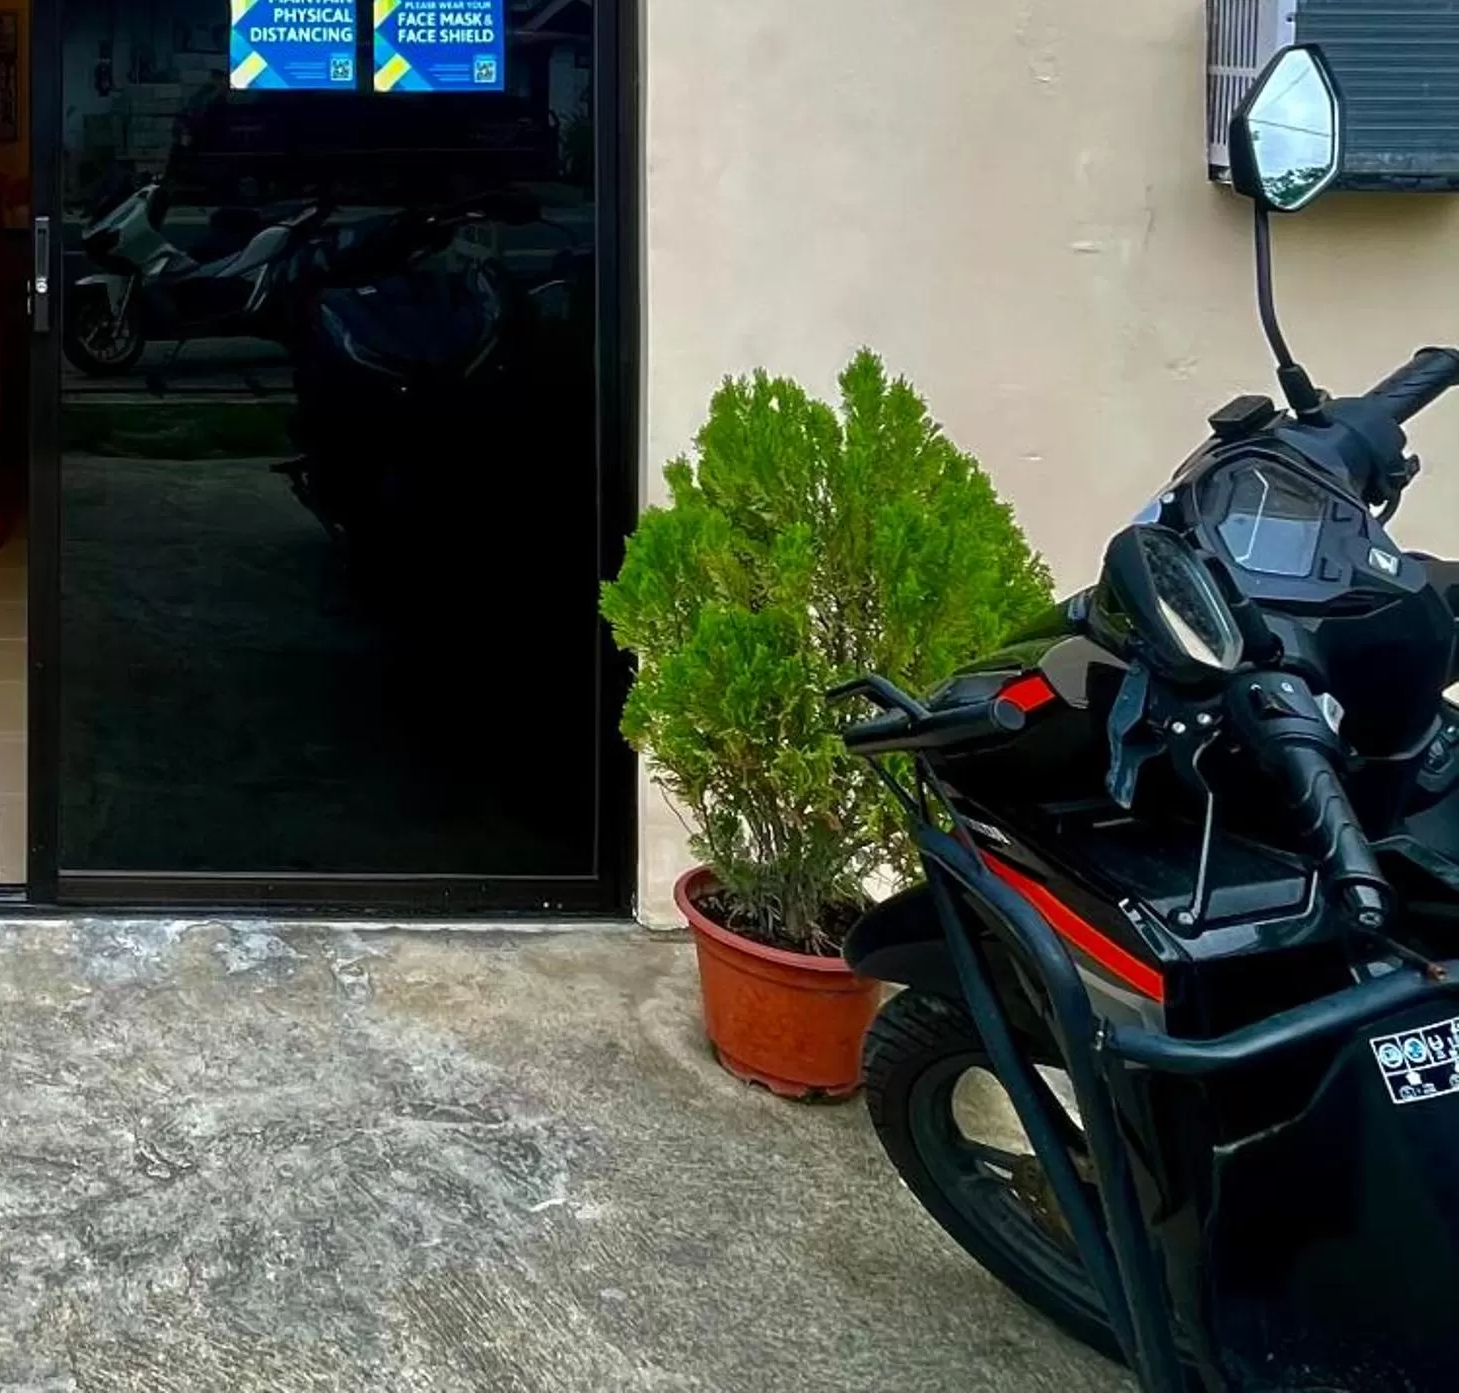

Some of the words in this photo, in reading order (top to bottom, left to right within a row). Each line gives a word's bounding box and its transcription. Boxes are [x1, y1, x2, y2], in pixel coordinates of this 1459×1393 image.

[274, 7, 354, 24] PHYSICAL
[397, 11, 437, 26] FACE
[439, 11, 482, 26] MASK
[250, 26, 354, 43] DISTANCING
[397, 28, 437, 43] FACE
[438, 28, 495, 43] SHIELD
